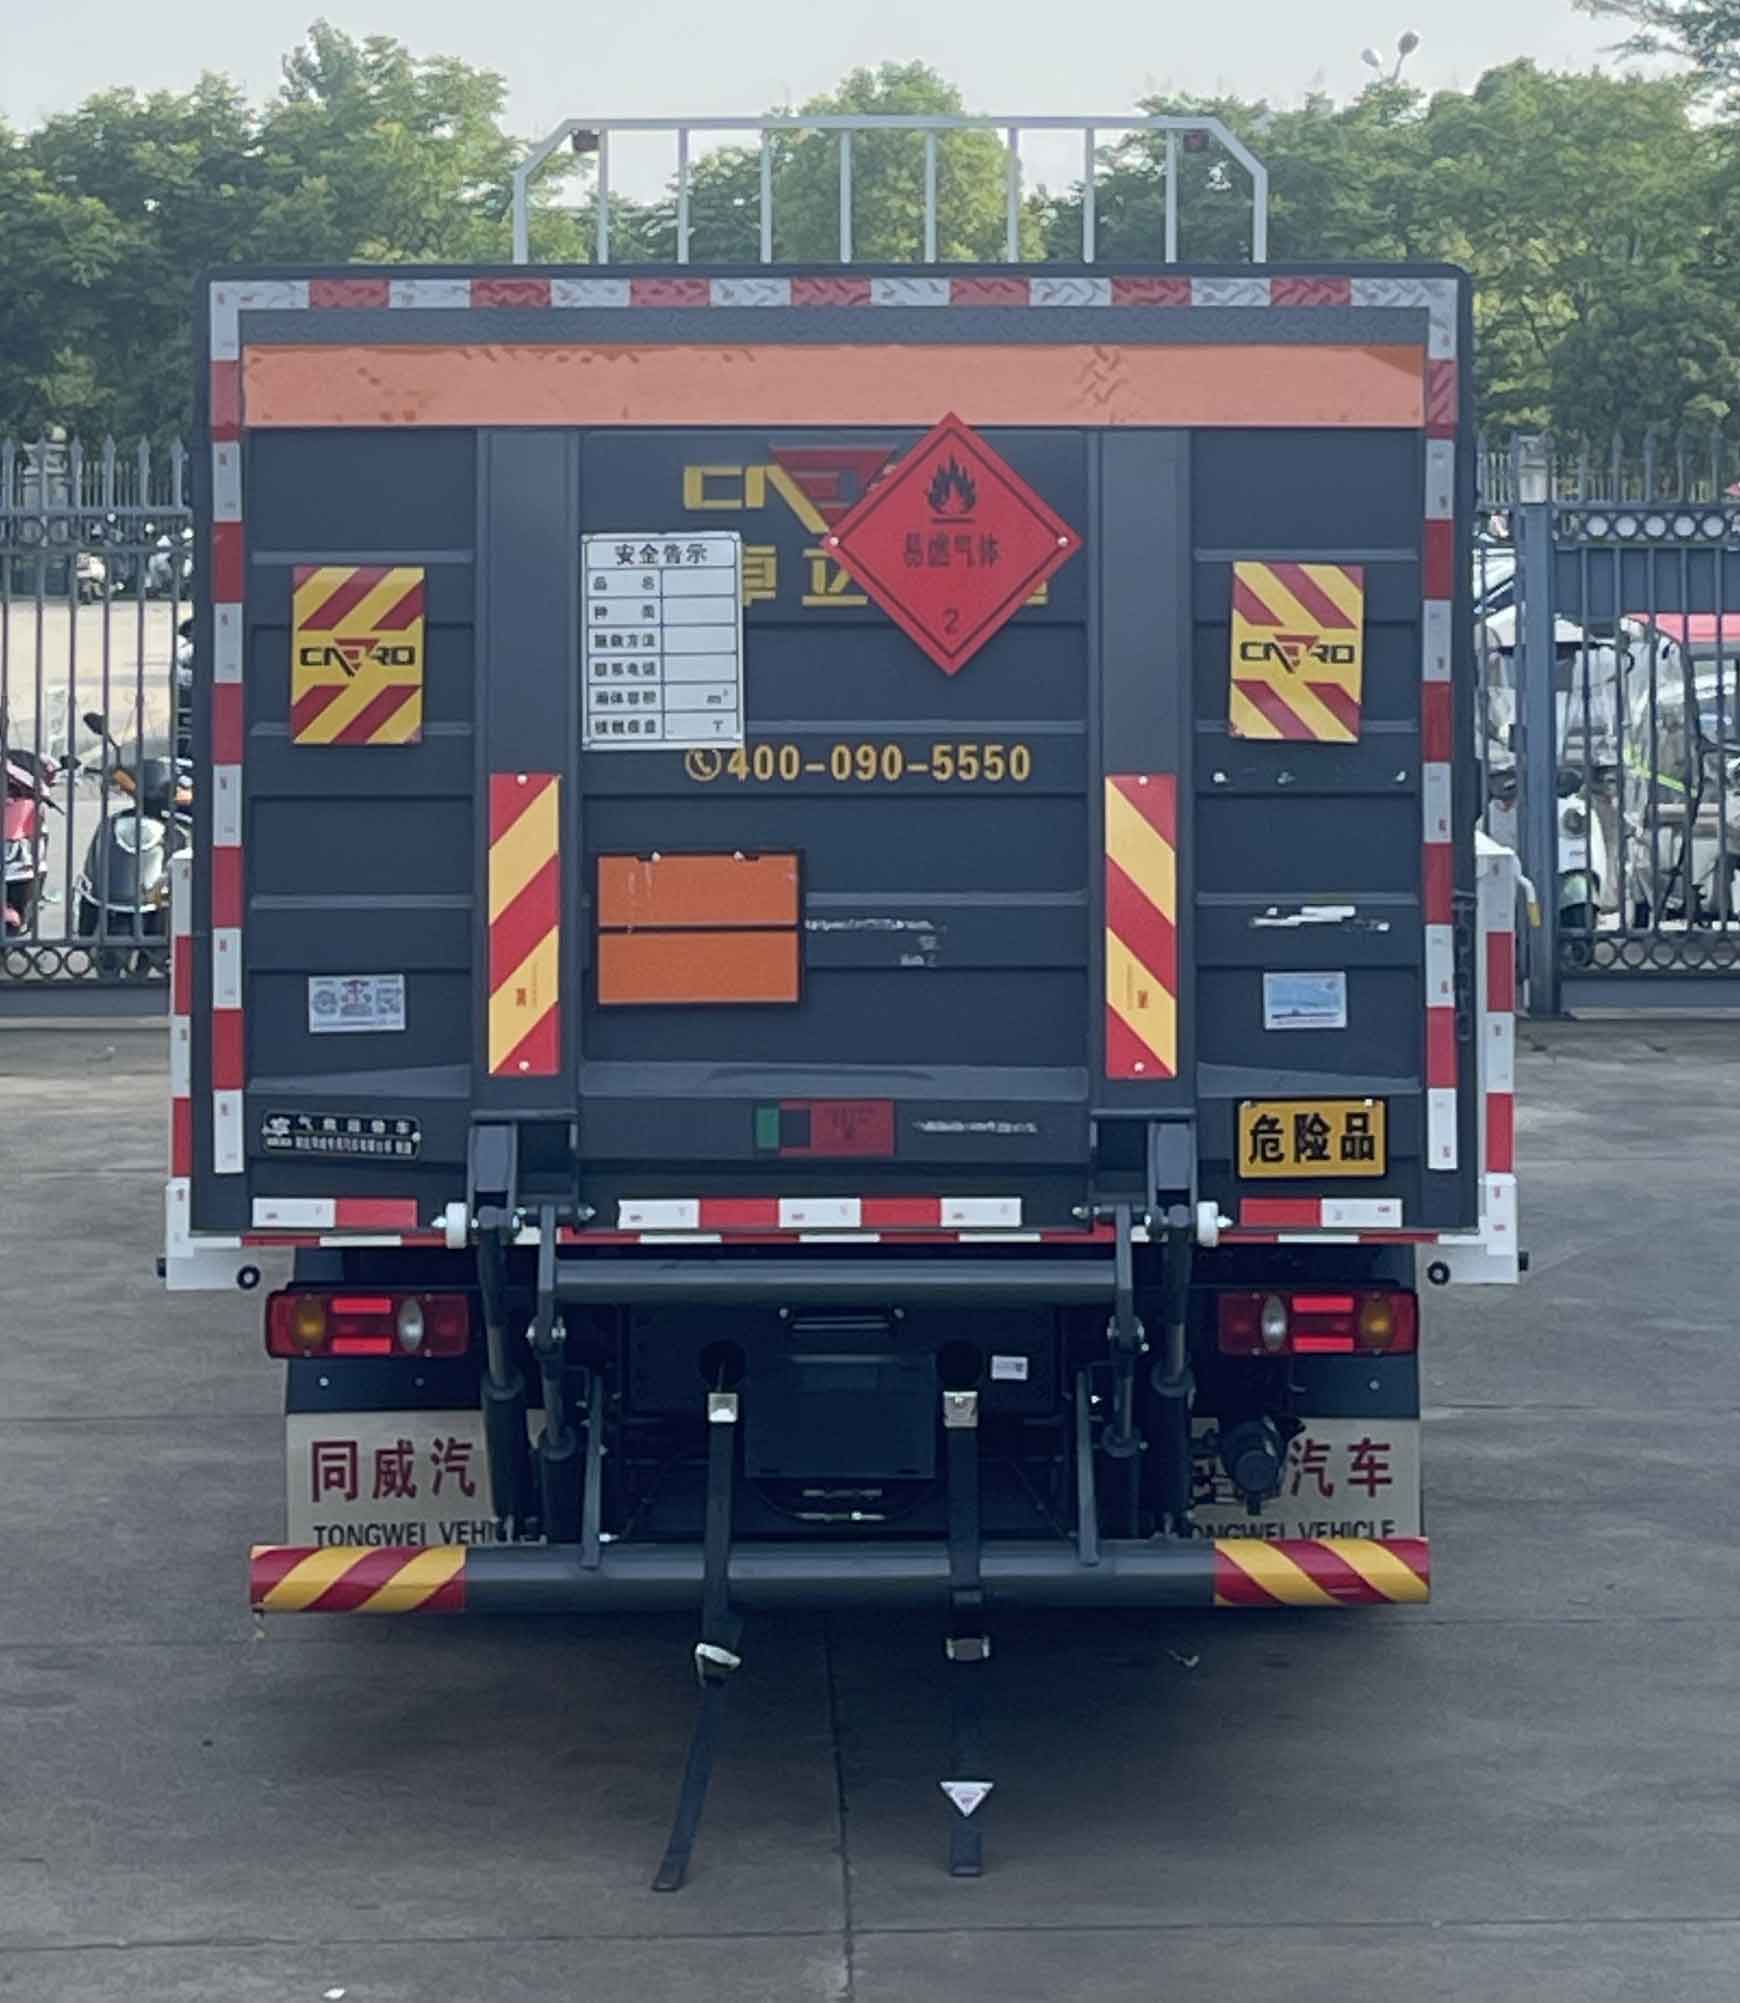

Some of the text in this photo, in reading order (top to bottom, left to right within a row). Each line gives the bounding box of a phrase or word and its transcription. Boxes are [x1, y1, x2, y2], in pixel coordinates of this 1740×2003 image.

[615, 544, 708, 566] 安全告示
[903, 532, 1001, 569] 易燃气体
[942, 607, 960, 636] 2
[726, 744, 1032, 782] 400-090-5550
[1248, 1112, 1376, 1164] 危险品
[314, 1520, 427, 1547] TONGWEI
